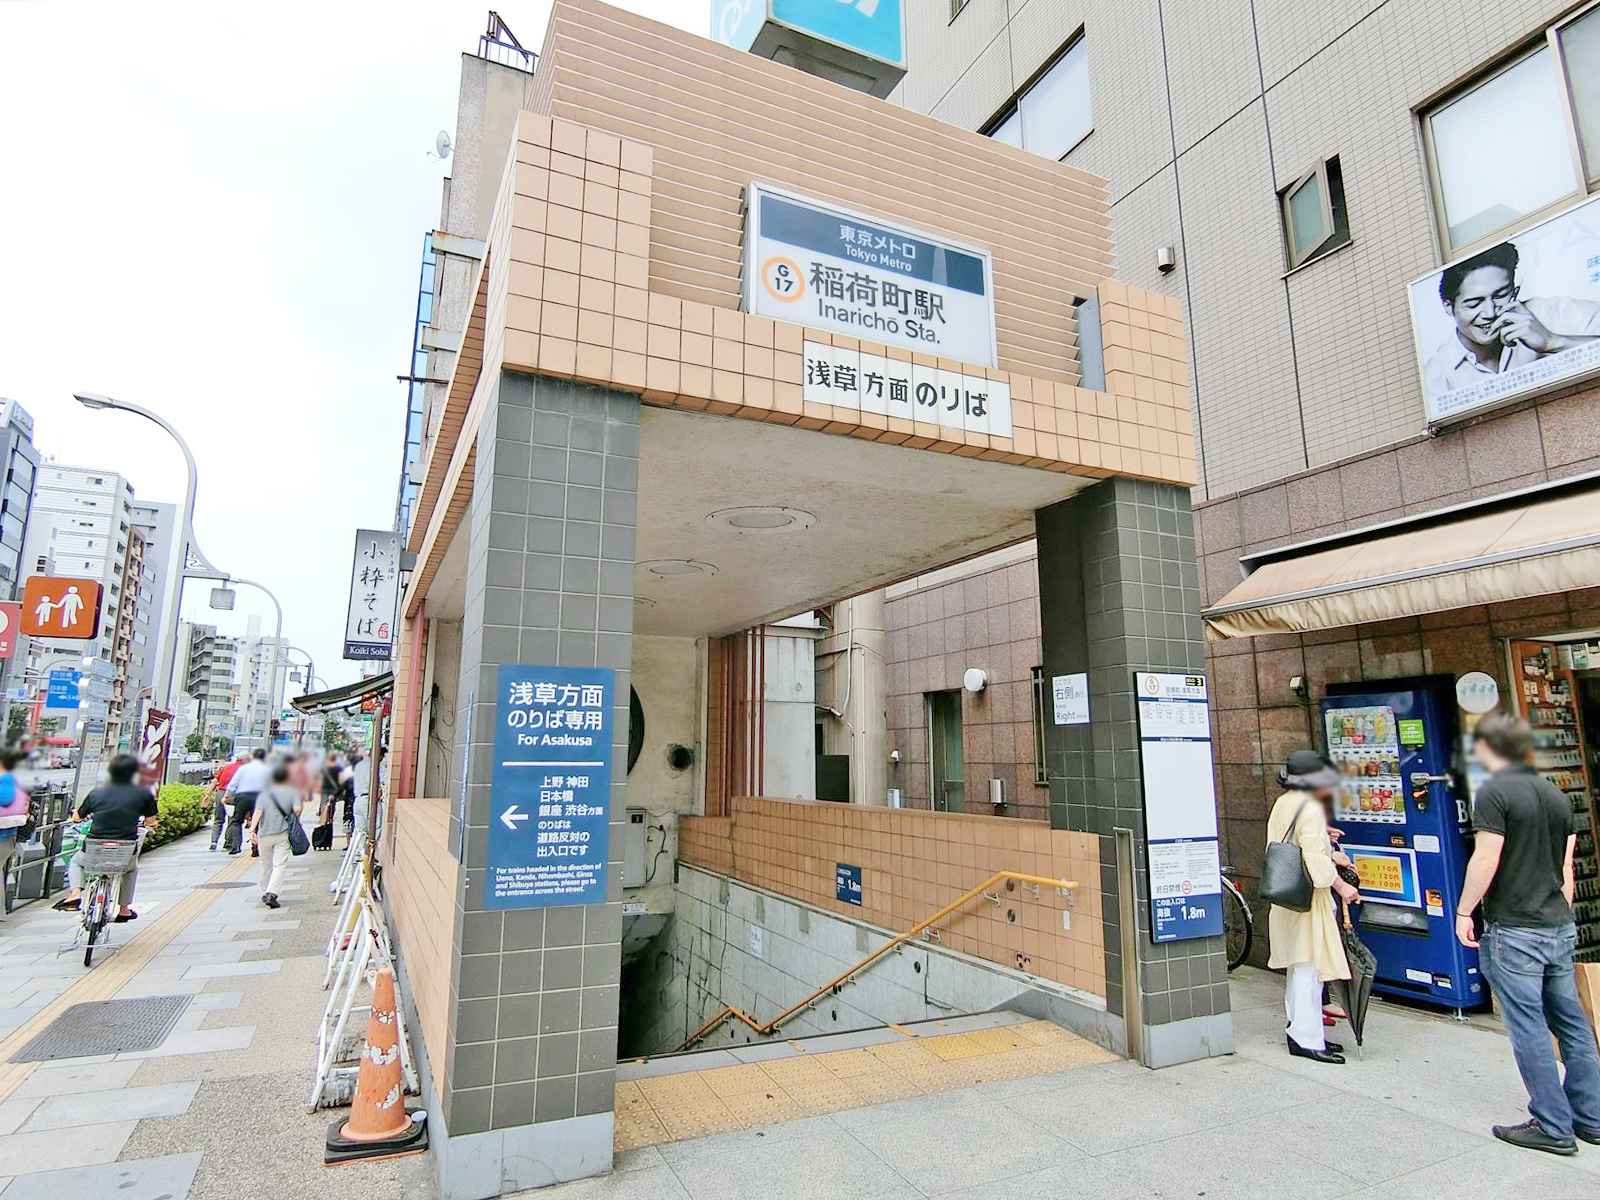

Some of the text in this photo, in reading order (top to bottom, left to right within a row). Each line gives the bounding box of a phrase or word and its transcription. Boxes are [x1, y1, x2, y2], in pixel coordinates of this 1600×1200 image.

[839, 225, 916, 259] 東京メトロ
[844, 244, 912, 273] Tokyo Metro
[778, 265, 788, 277] G
[775, 278, 793, 292] 17
[810, 261, 946, 324] 稲荷町駅
[818, 299, 941, 344] Inarichō Sta.
[807, 358, 988, 417] 浅草方面のりば
[357, 541, 384, 635] 小粋そば
[349, 646, 388, 656] Koiki Soba
[509, 682, 604, 707] 浅草方面
[508, 709, 602, 730] のりば専用
[1056, 711, 1075, 722] Right
[517, 734, 593, 746] For Asakusa
[540, 776, 589, 788] 上野 神田
[540, 790, 574, 802] 日本橋
[539, 804, 562, 816] 銀座
[538, 820, 571, 829] のりばは
[537, 831, 590, 843] 道路反対の
[537, 844, 588, 857] 出入口です
[568, 863, 594, 871] direction
[595, 862, 602, 870] of
[1181, 905, 1206, 920] 1.8m
